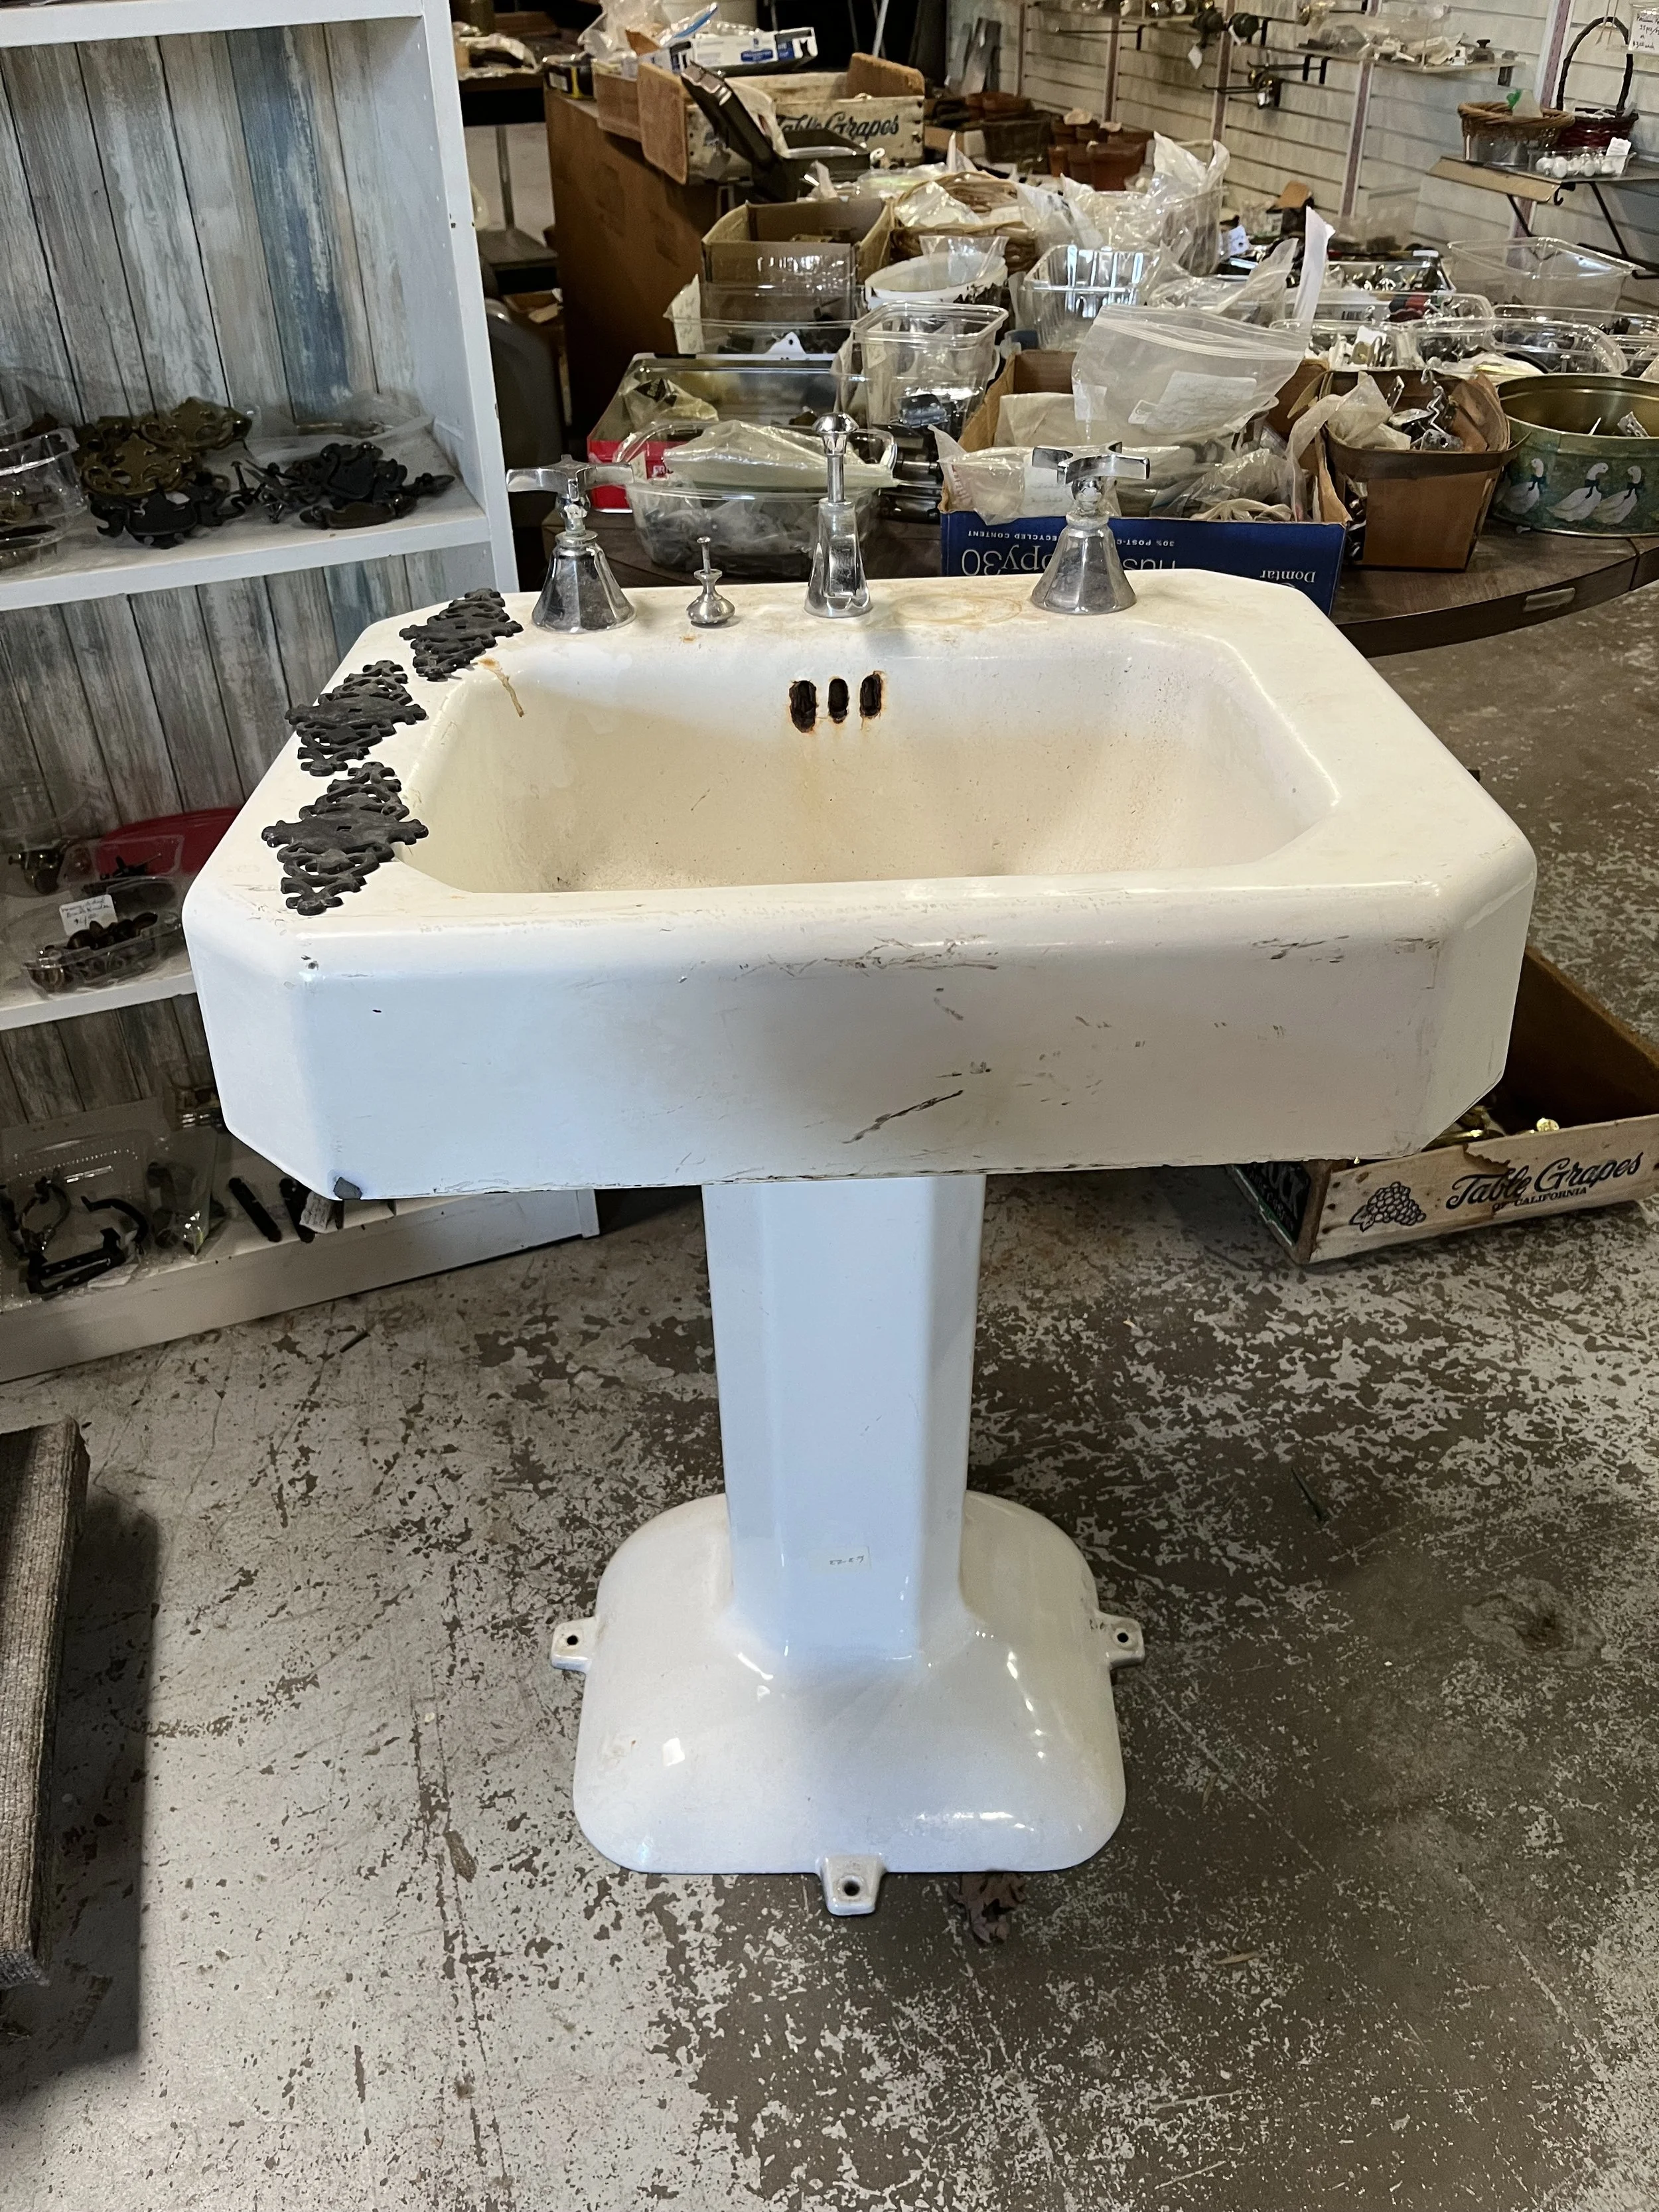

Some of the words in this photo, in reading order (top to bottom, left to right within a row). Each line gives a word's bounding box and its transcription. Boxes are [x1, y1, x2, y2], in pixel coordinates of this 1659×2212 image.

[824, 111, 899, 141] Grapes
[968, 530, 1010, 539] CONTENT
[1014, 533, 1058, 542] ECYCLED
[1260, 570, 1317, 583] Domtar
[1445, 1165, 1532, 1209] Table
[1534, 1151, 1644, 1193] Grapes
[1514, 1187, 1587, 1207] CALIFORNIA
